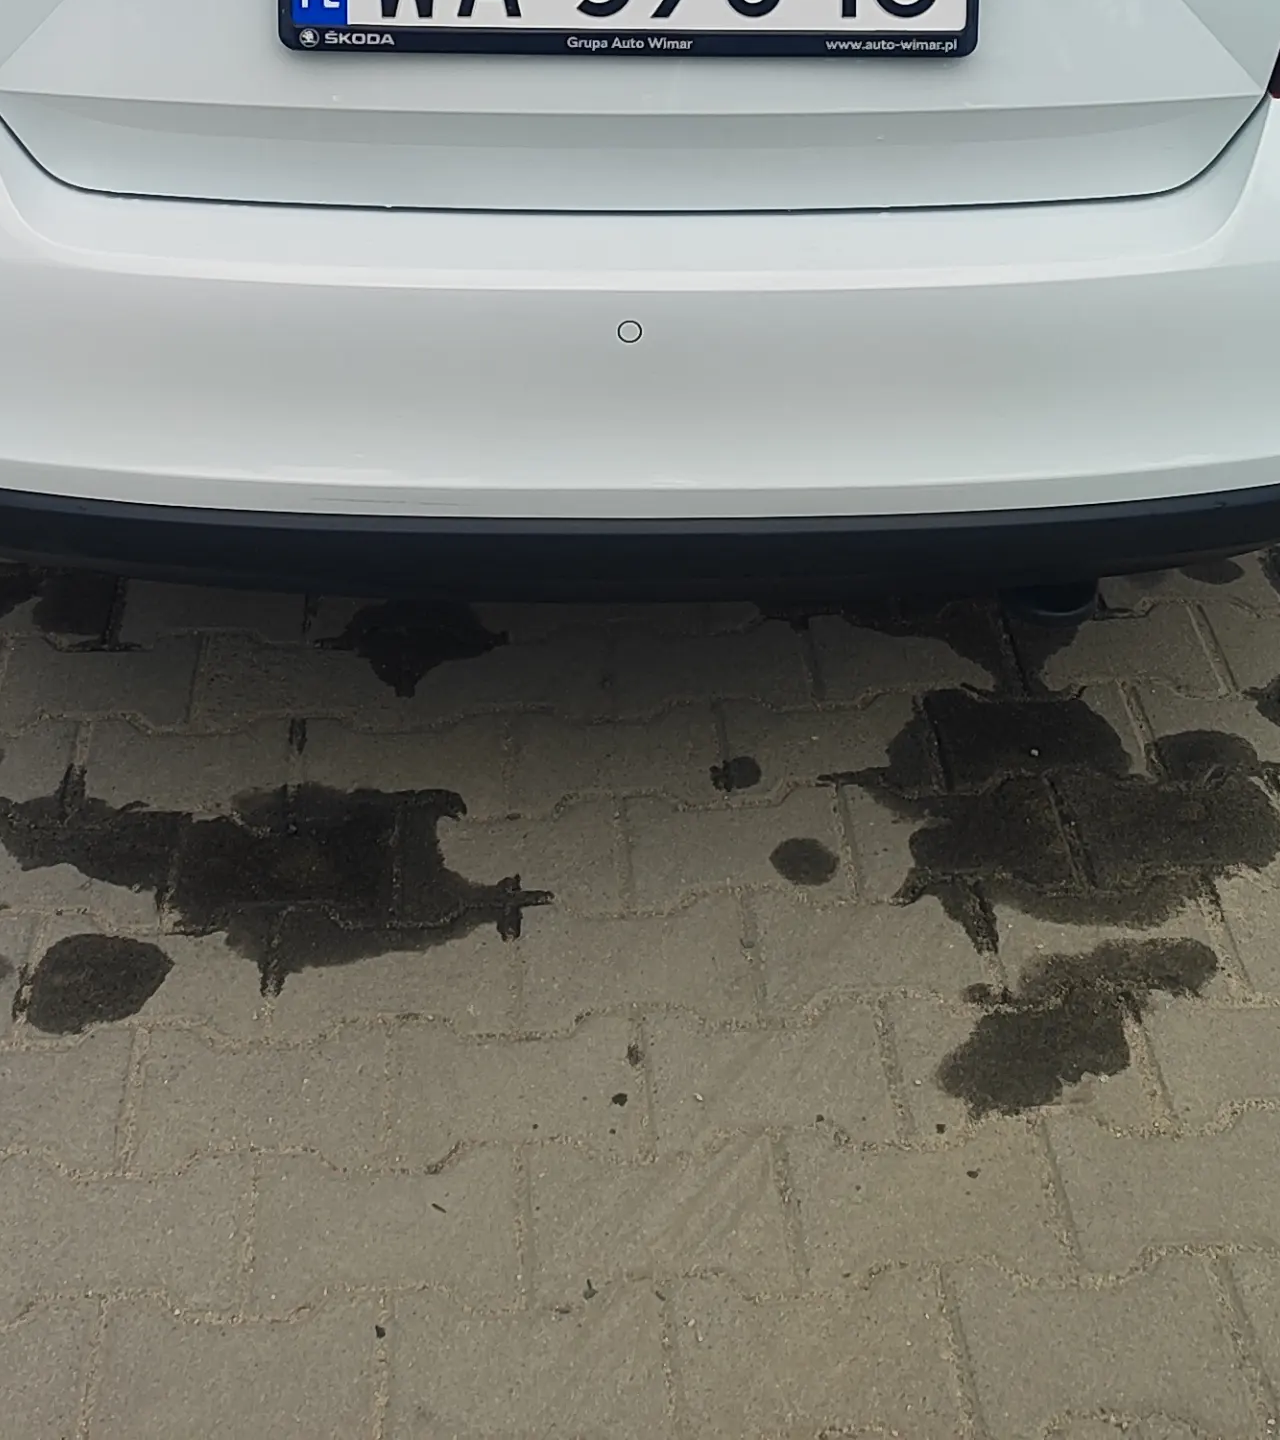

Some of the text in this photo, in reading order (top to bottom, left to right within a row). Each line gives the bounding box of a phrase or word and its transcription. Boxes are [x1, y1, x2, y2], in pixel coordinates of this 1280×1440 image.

[325, 31, 395, 46] ŠKODA
[566, 36, 693, 51] Grupa Auto Wimar
[825, 38, 958, 53] www.auto-wimar.pl
